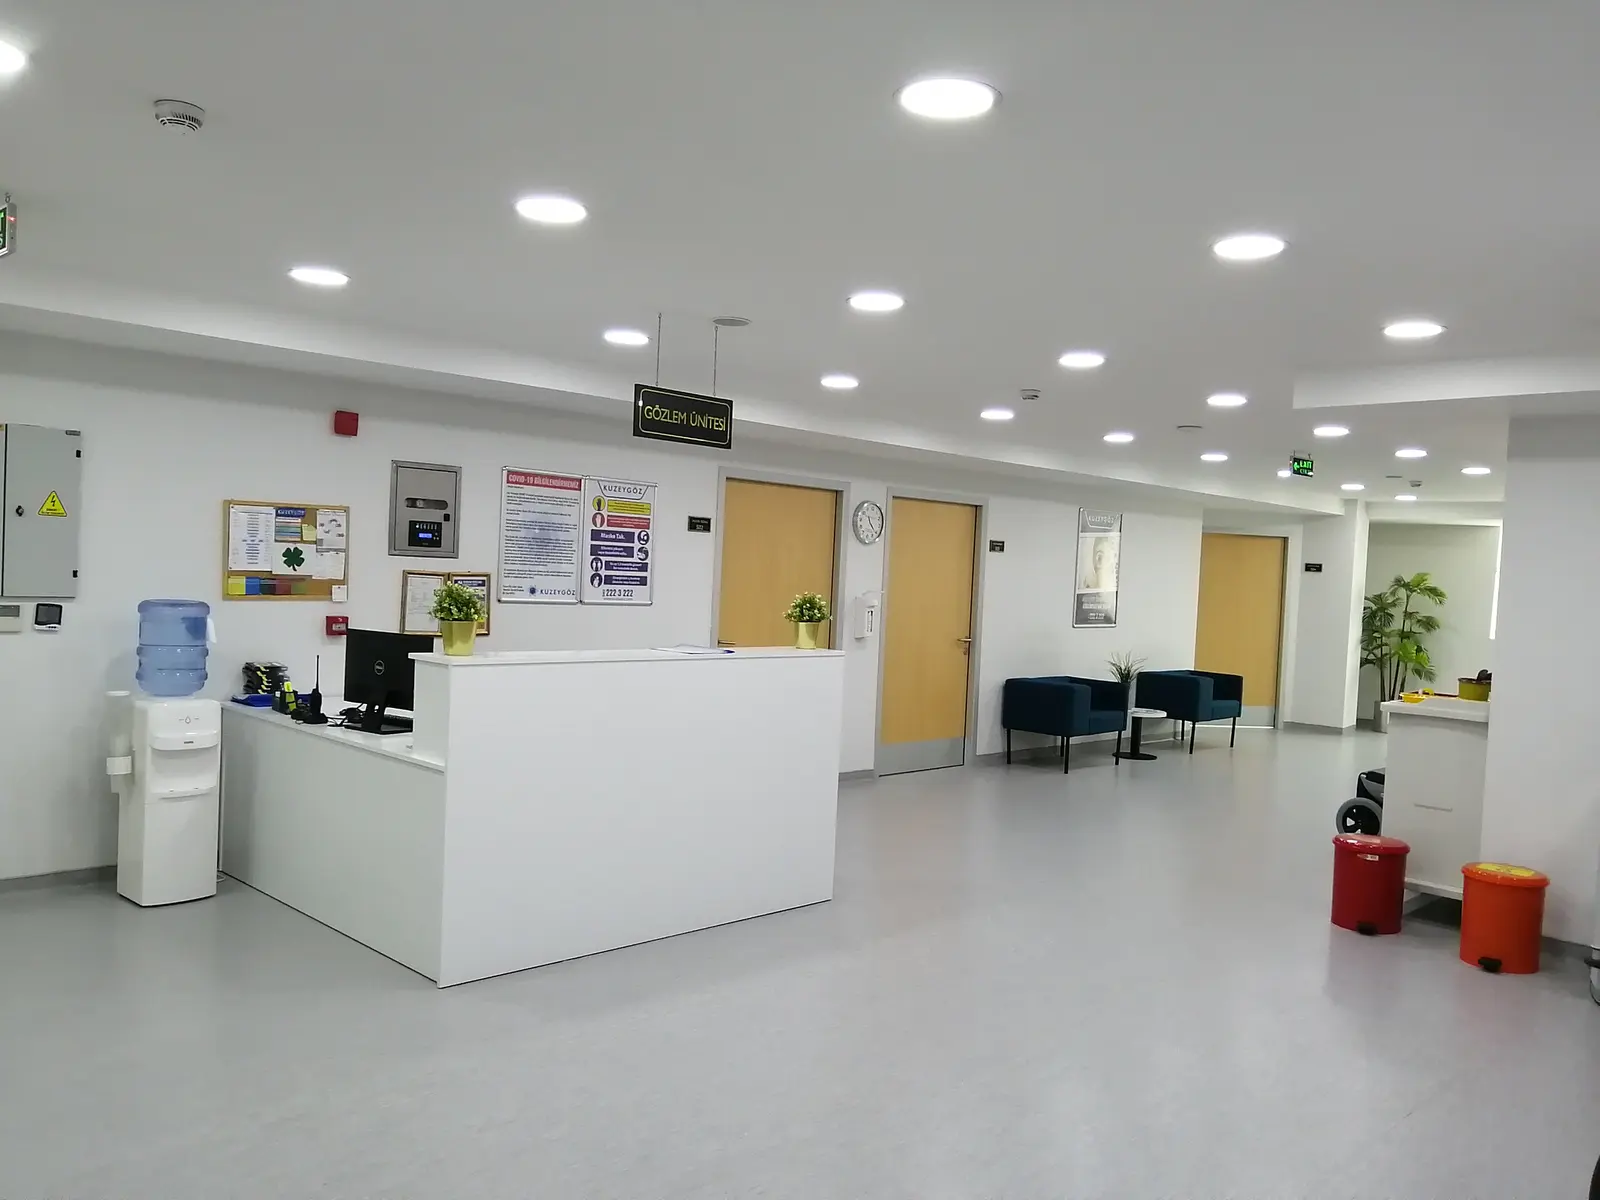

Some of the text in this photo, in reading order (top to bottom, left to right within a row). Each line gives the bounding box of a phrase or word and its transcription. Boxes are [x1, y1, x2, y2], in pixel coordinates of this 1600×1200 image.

[644, 404, 726, 431] GÖZLEM ÜNİTESİ
[508, 474, 534, 484] COVID-19
[603, 484, 643, 495] KUZEYGÖZ
[540, 588, 576, 596] KUZEYGÖZ
[606, 588, 617, 597] 222
[622, 589, 634, 597] 222
